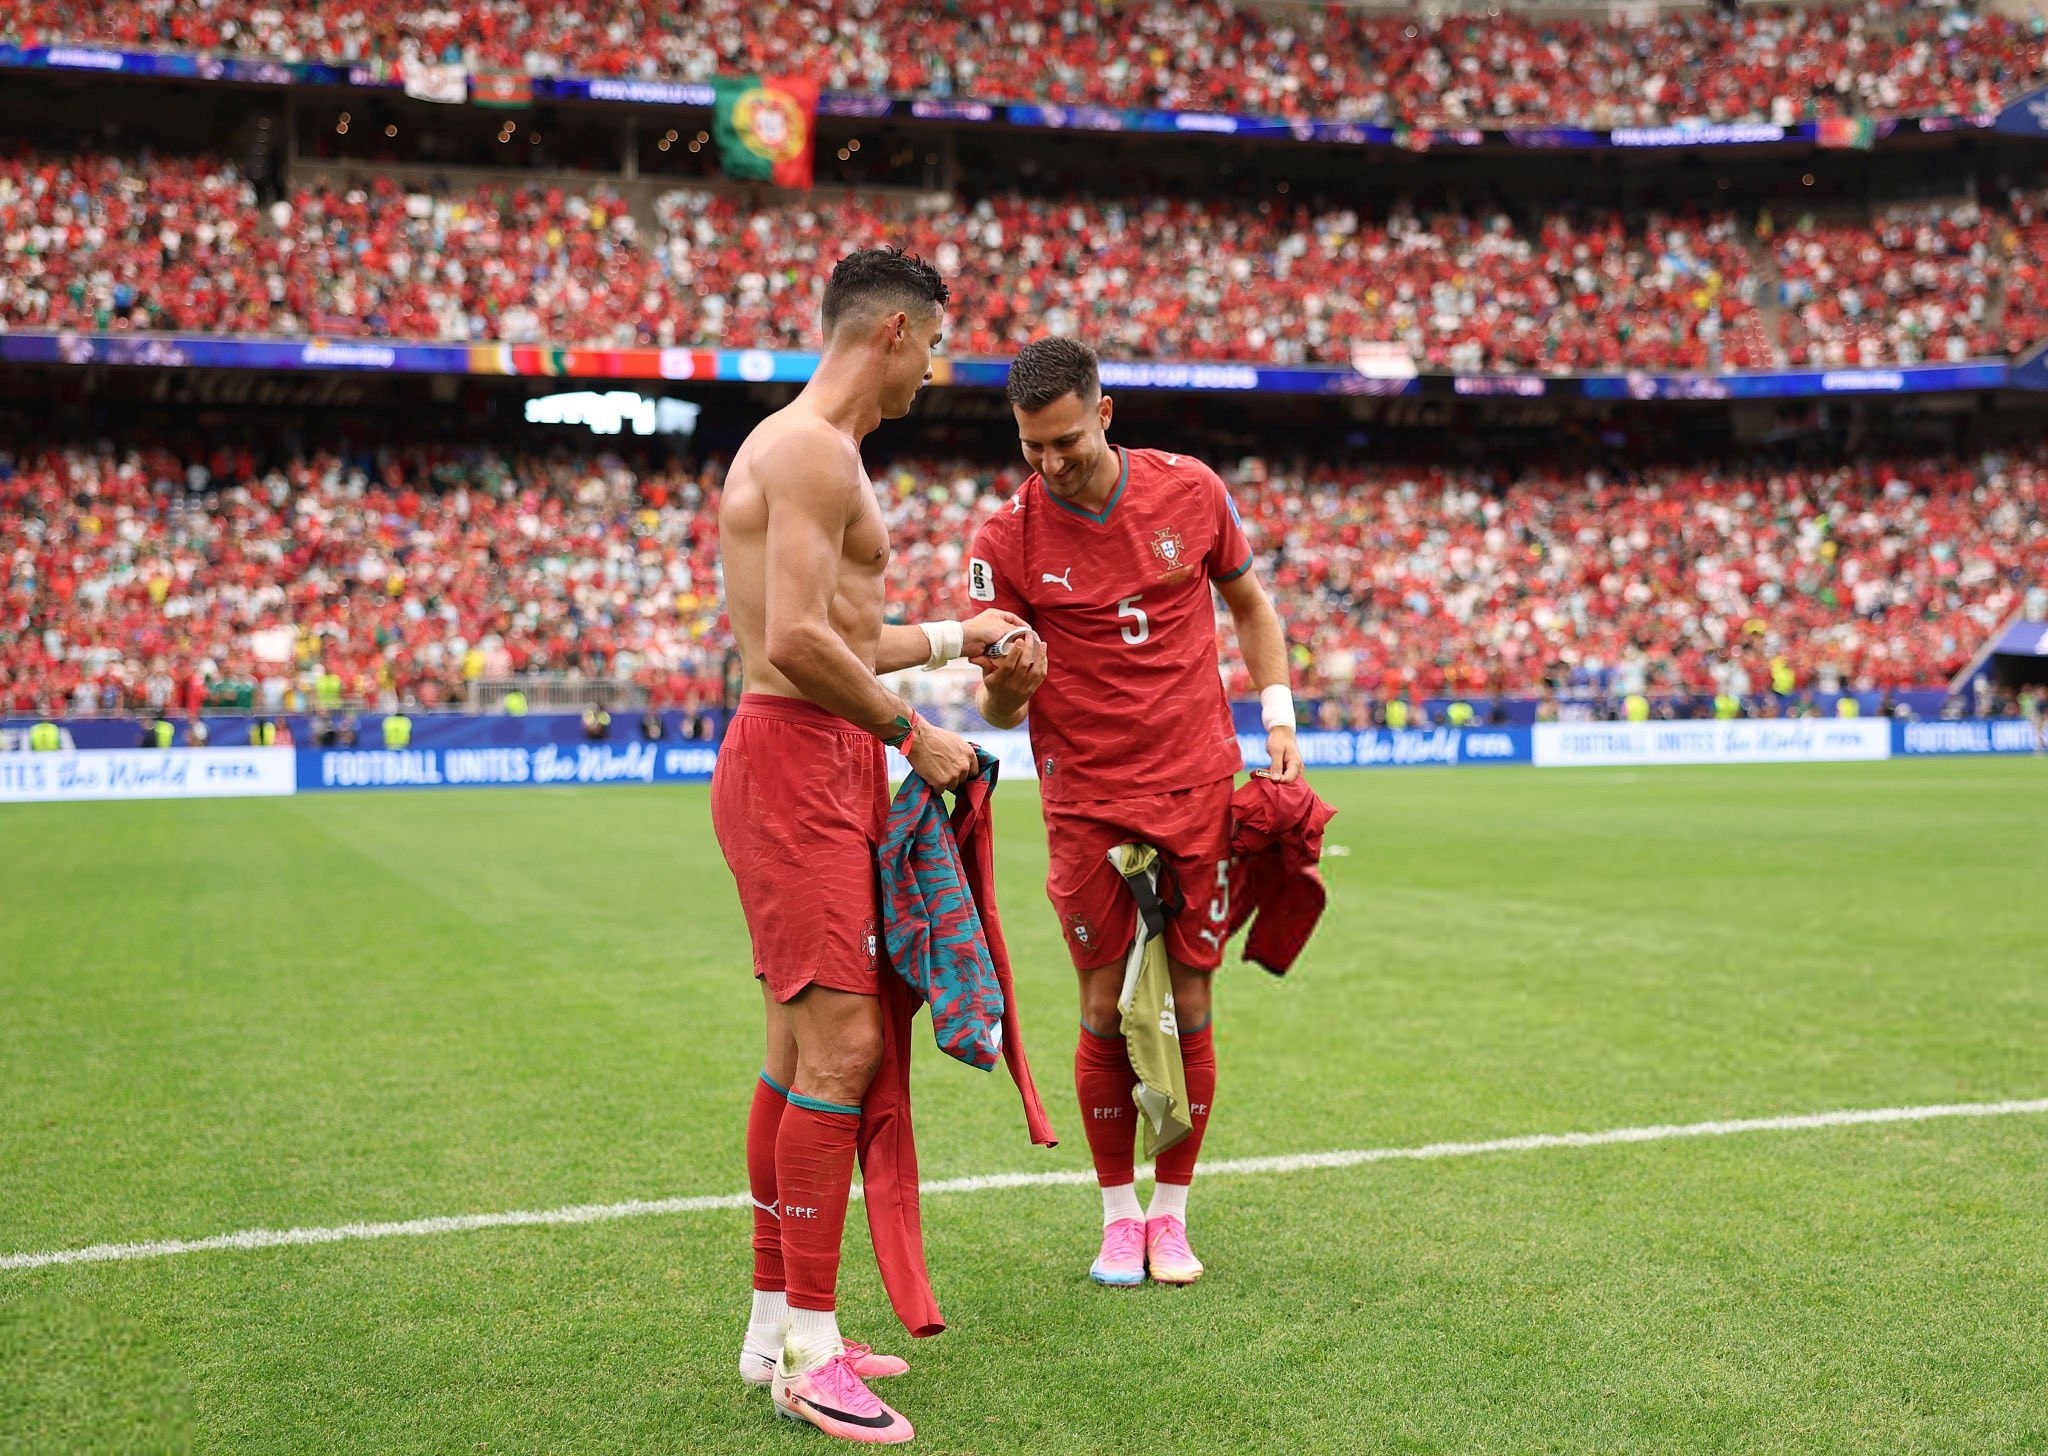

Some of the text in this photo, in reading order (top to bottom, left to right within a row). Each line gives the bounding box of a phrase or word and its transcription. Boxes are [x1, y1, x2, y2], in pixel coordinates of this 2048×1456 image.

[1115, 593, 1150, 645] 5
[1298, 732, 1354, 765] NITES
[1903, 721, 1990, 753] FOOTBALL
[322, 750, 443, 787] FOOTBALL
[444, 747, 530, 783] UNITES
[576, 741, 658, 783] World
